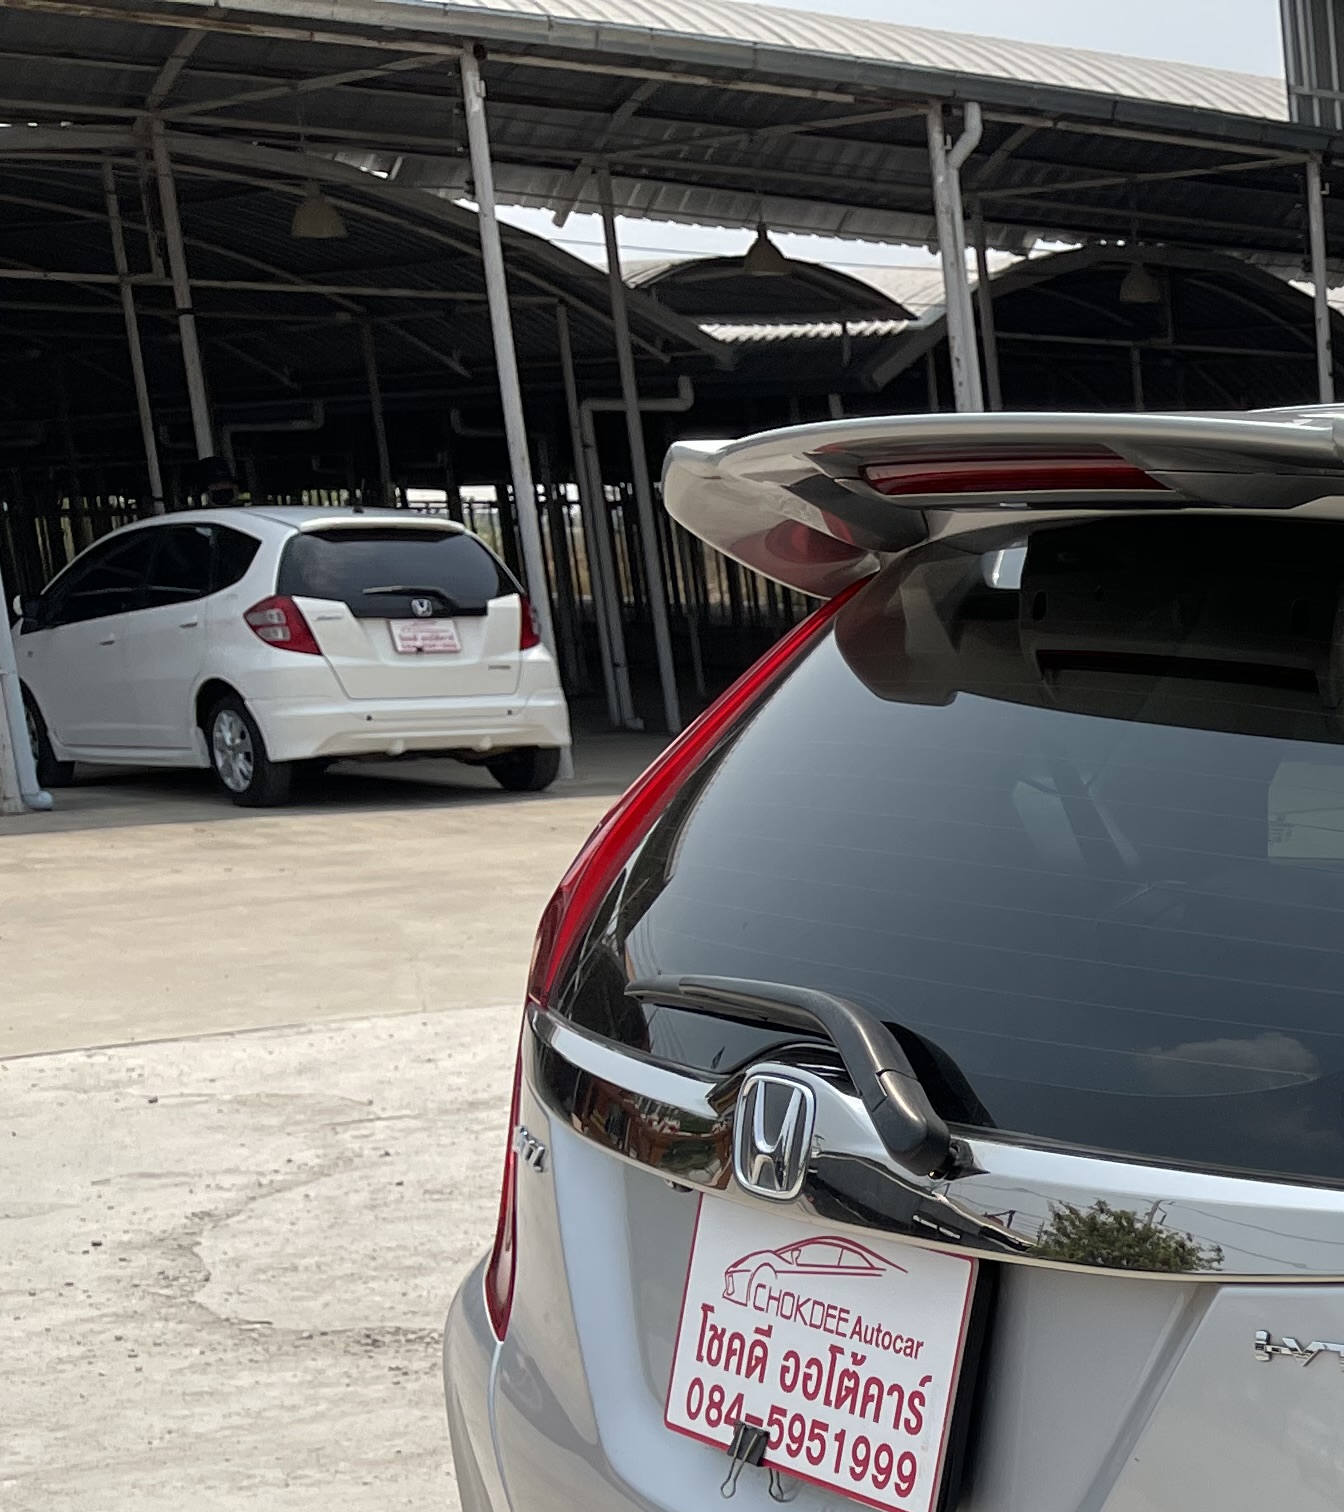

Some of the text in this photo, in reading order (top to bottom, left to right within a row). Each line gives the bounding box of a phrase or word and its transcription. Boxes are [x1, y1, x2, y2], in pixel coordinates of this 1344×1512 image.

[696, 1304, 933, 1436] โชคดี ออโต้คาร์
[752, 1282, 925, 1360] CHOKDEE Autocar
[685, 1377, 917, 1498] 084-5951999
